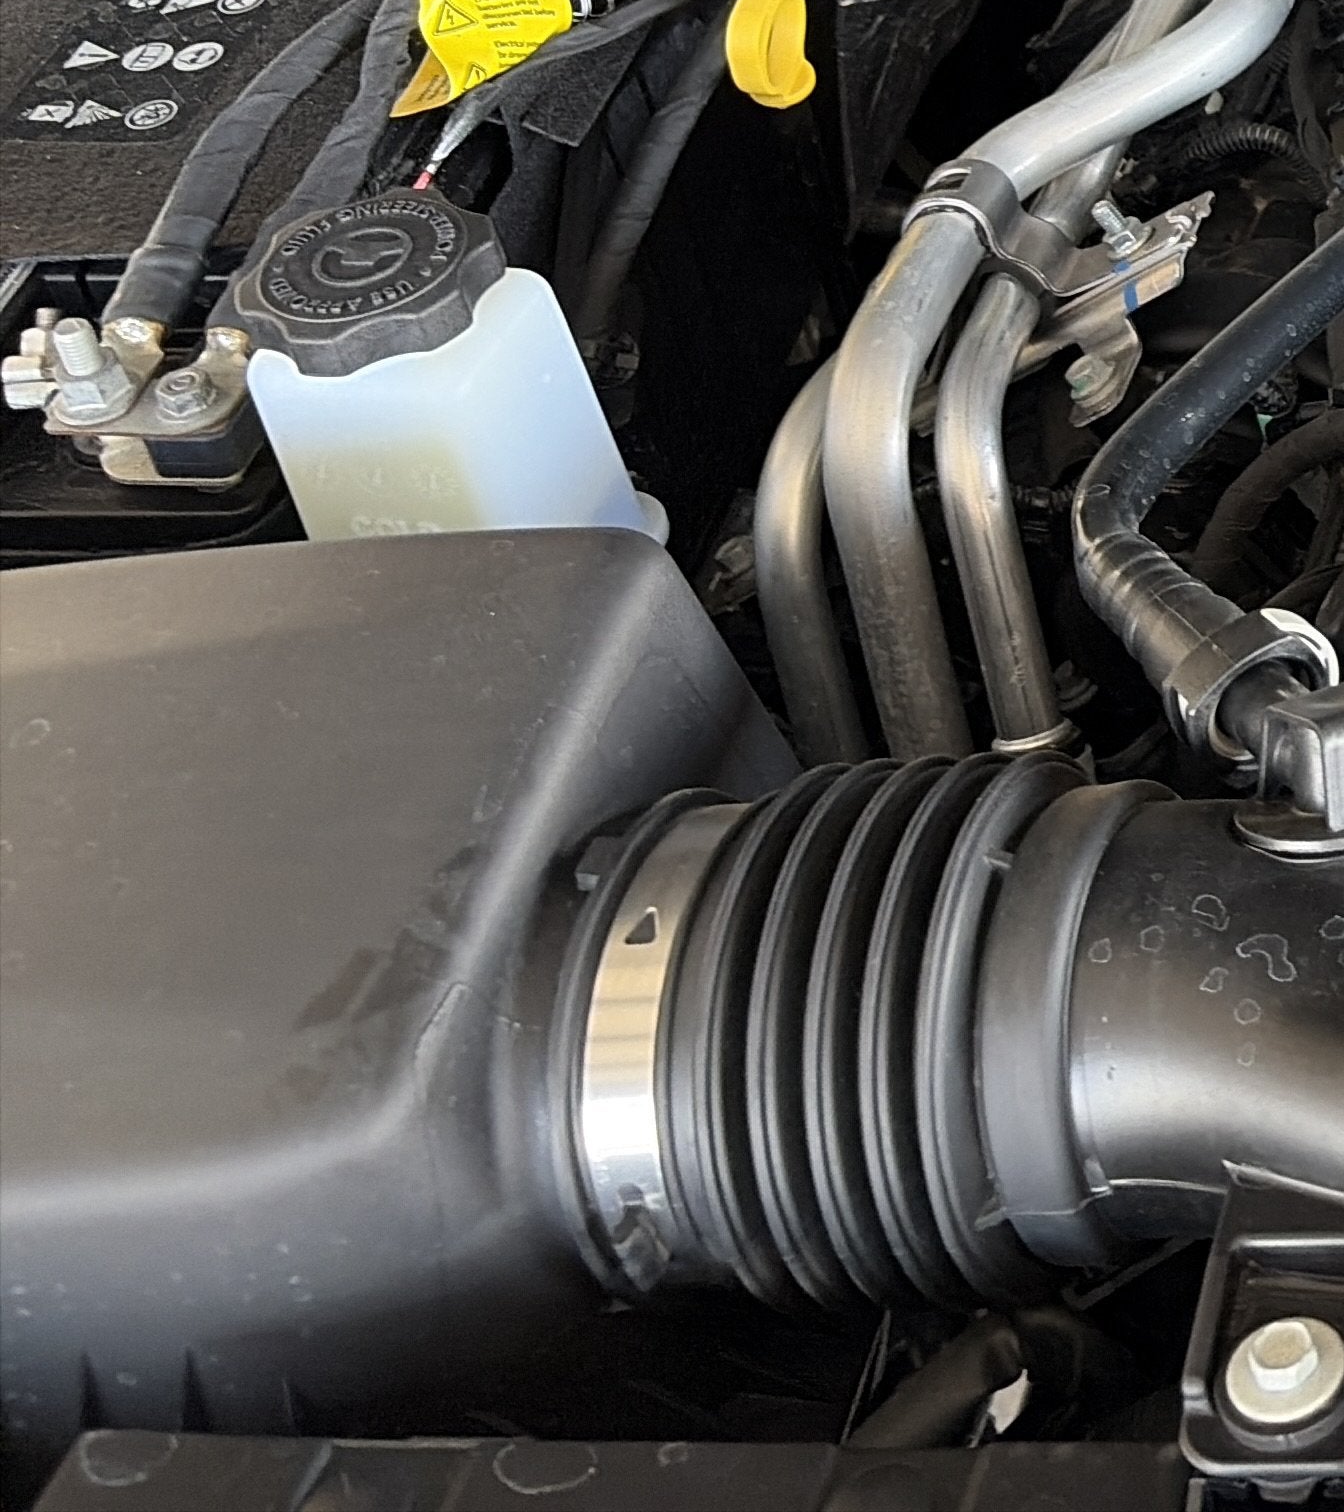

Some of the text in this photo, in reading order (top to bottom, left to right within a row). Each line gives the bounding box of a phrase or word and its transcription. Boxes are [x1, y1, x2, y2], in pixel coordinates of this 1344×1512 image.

[280, 220, 332, 256] FLUID
[269, 277, 415, 314] USE APPROVED
